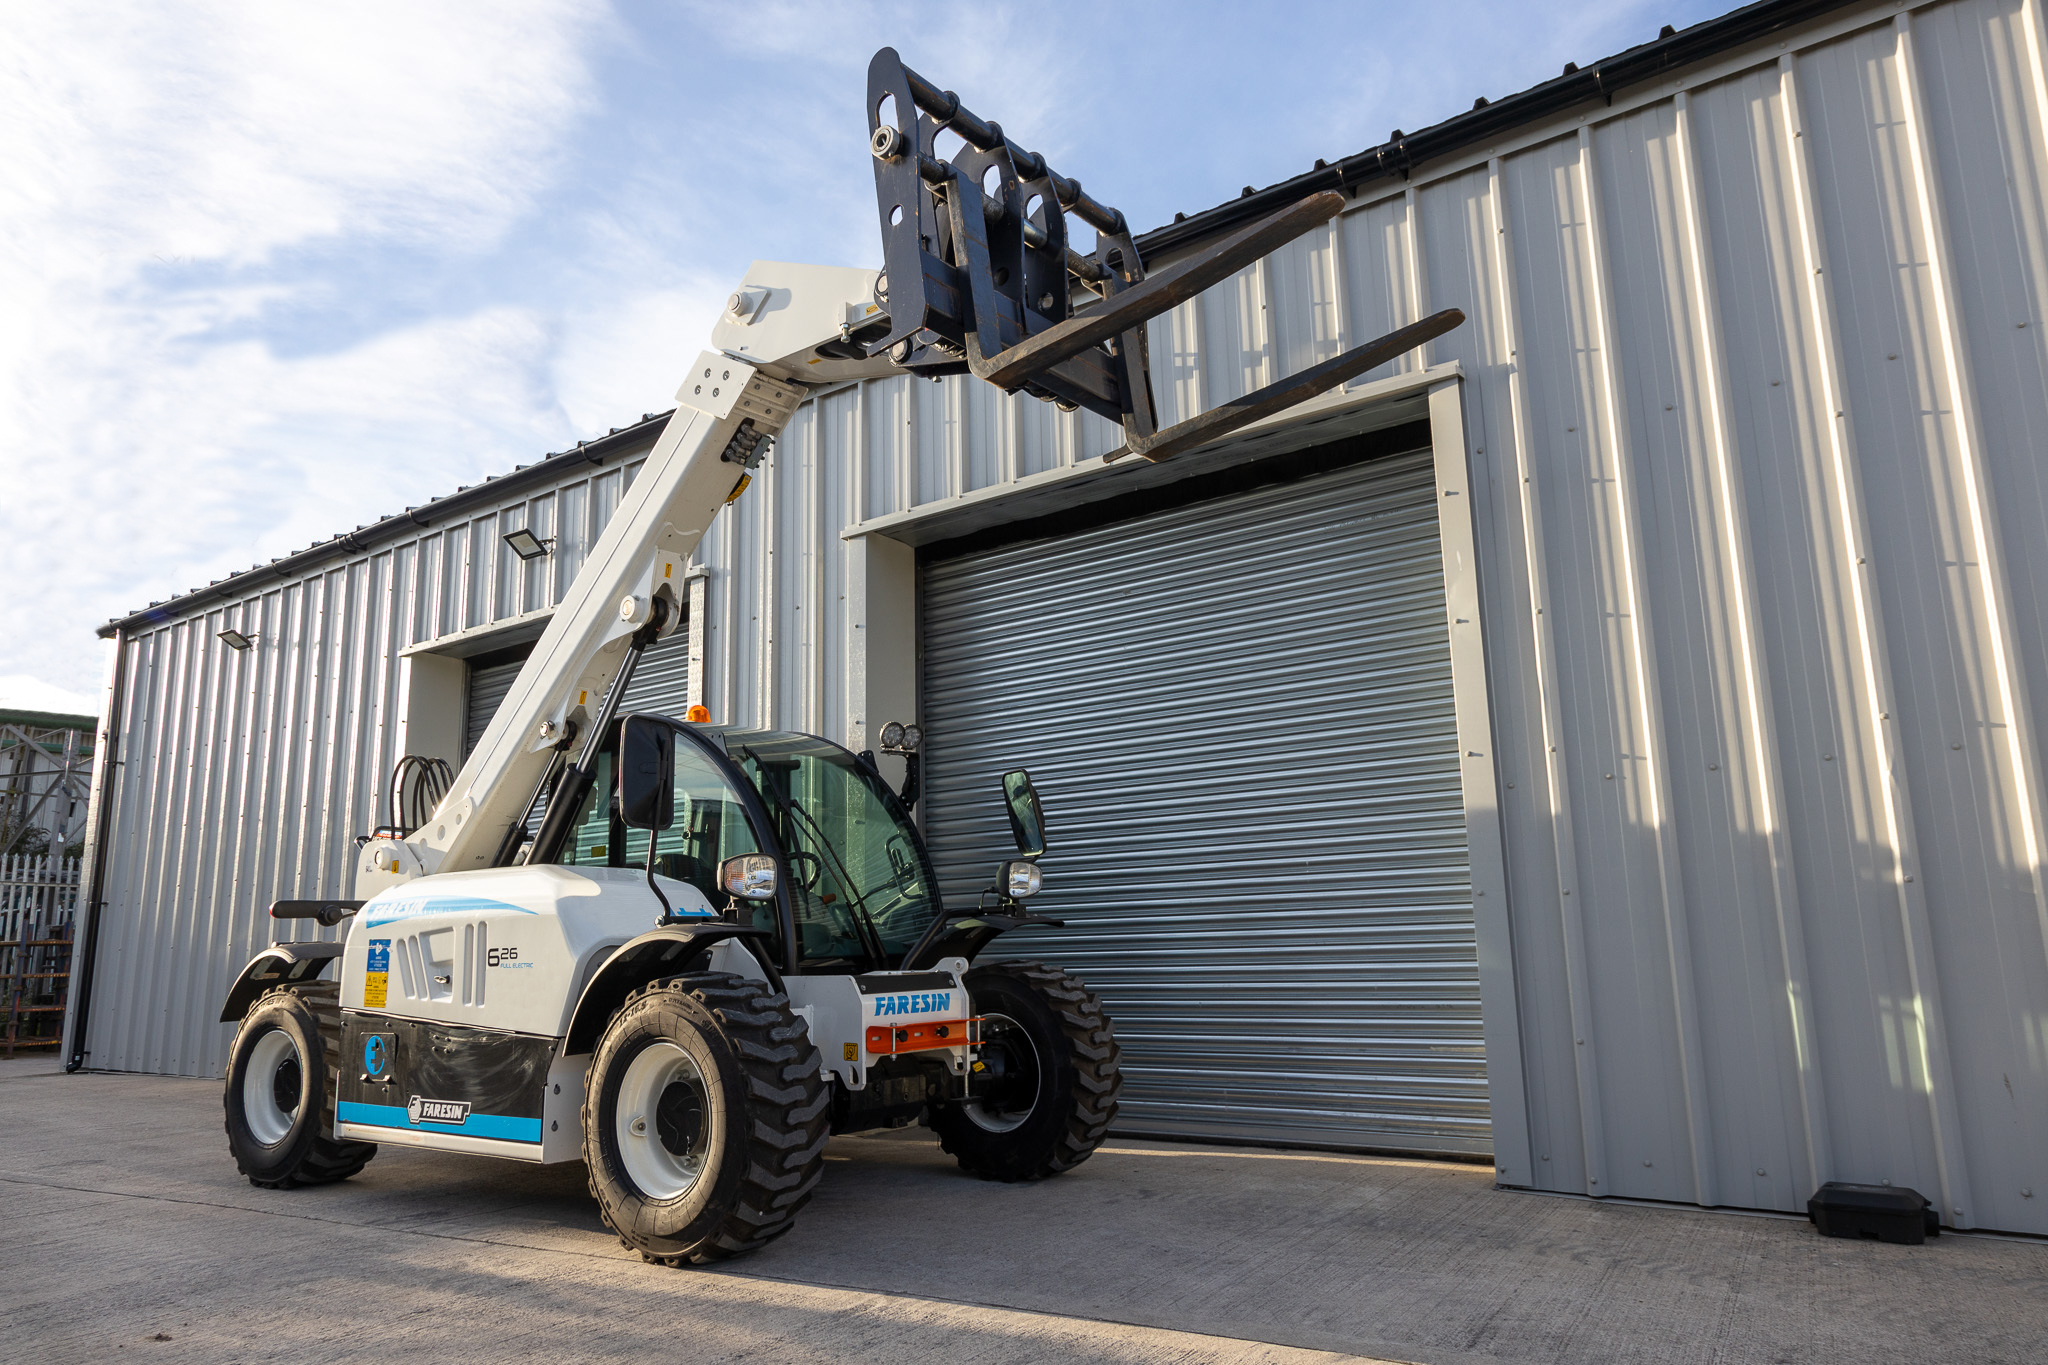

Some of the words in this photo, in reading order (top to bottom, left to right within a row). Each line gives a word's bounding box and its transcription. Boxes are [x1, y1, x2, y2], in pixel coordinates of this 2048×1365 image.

[370, 898, 430, 922] FARESIN
[488, 947, 518, 967] 626
[874, 993, 950, 1016] FARESIN
[422, 1102, 464, 1119] FARESIN
